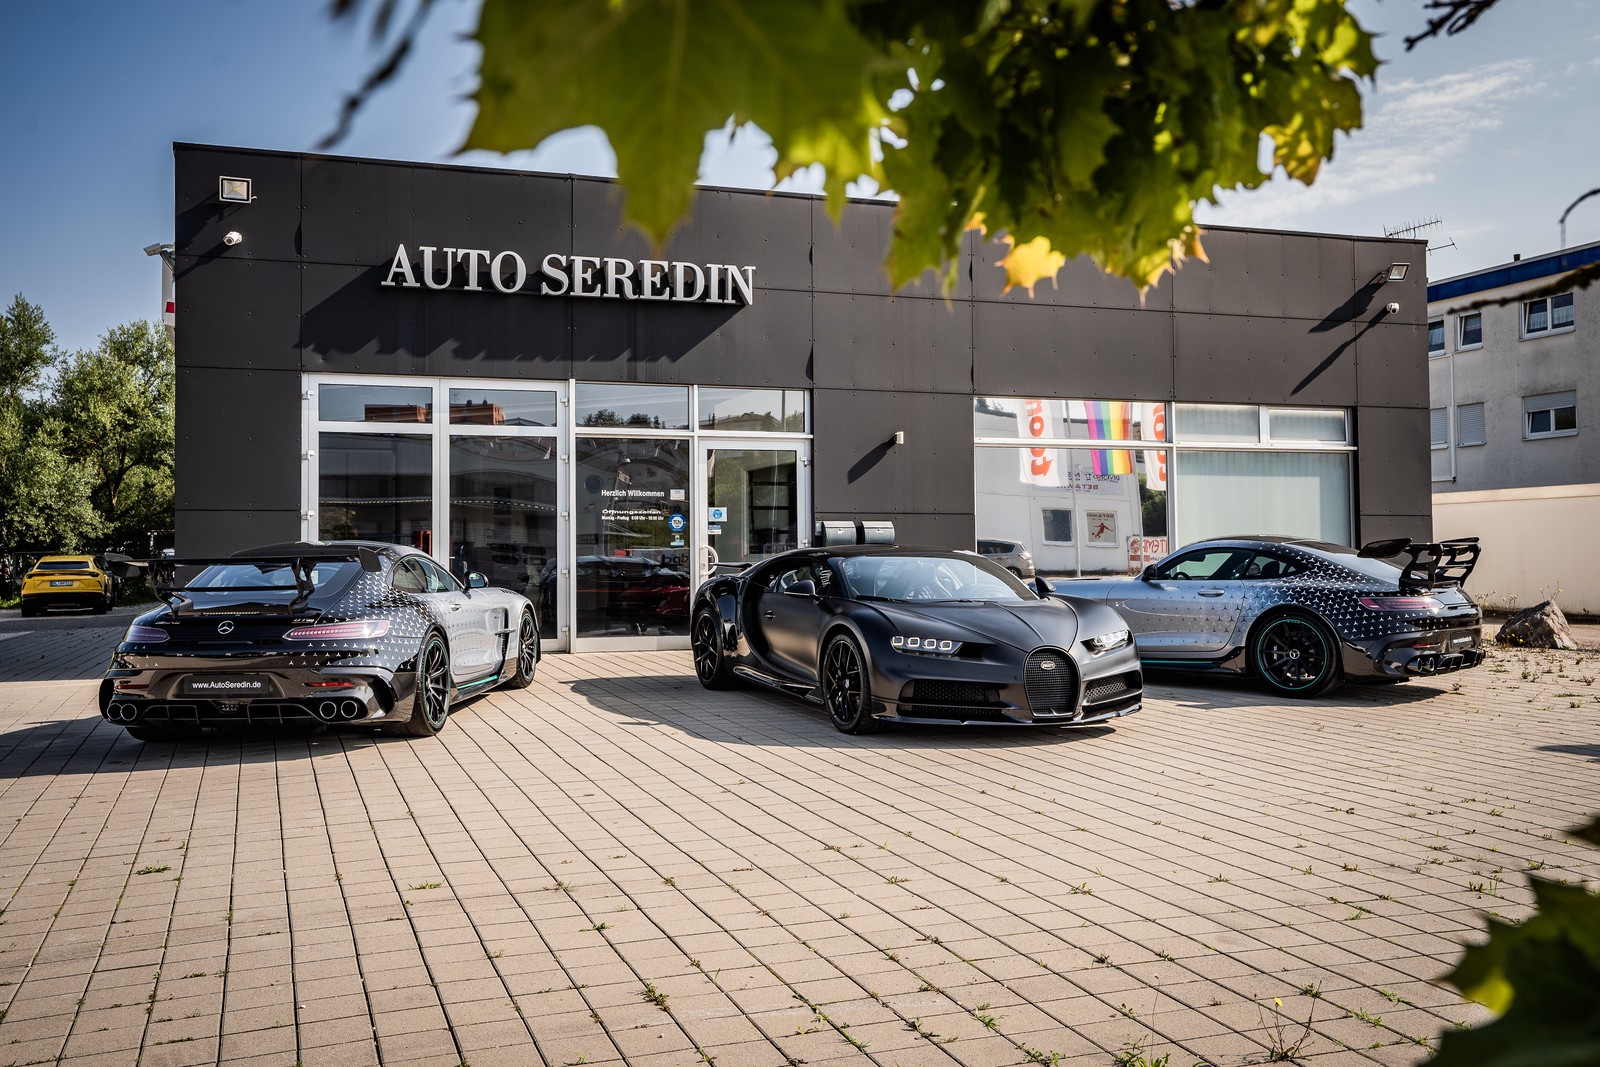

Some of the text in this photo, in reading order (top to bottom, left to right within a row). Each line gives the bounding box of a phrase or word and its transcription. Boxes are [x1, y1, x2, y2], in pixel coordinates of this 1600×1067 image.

[381, 243, 757, 305] AUTO SEREDIN
[601, 489, 665, 497] Herzlich Willkommen
[192, 680, 262, 689] www.AutoSeredin.de
